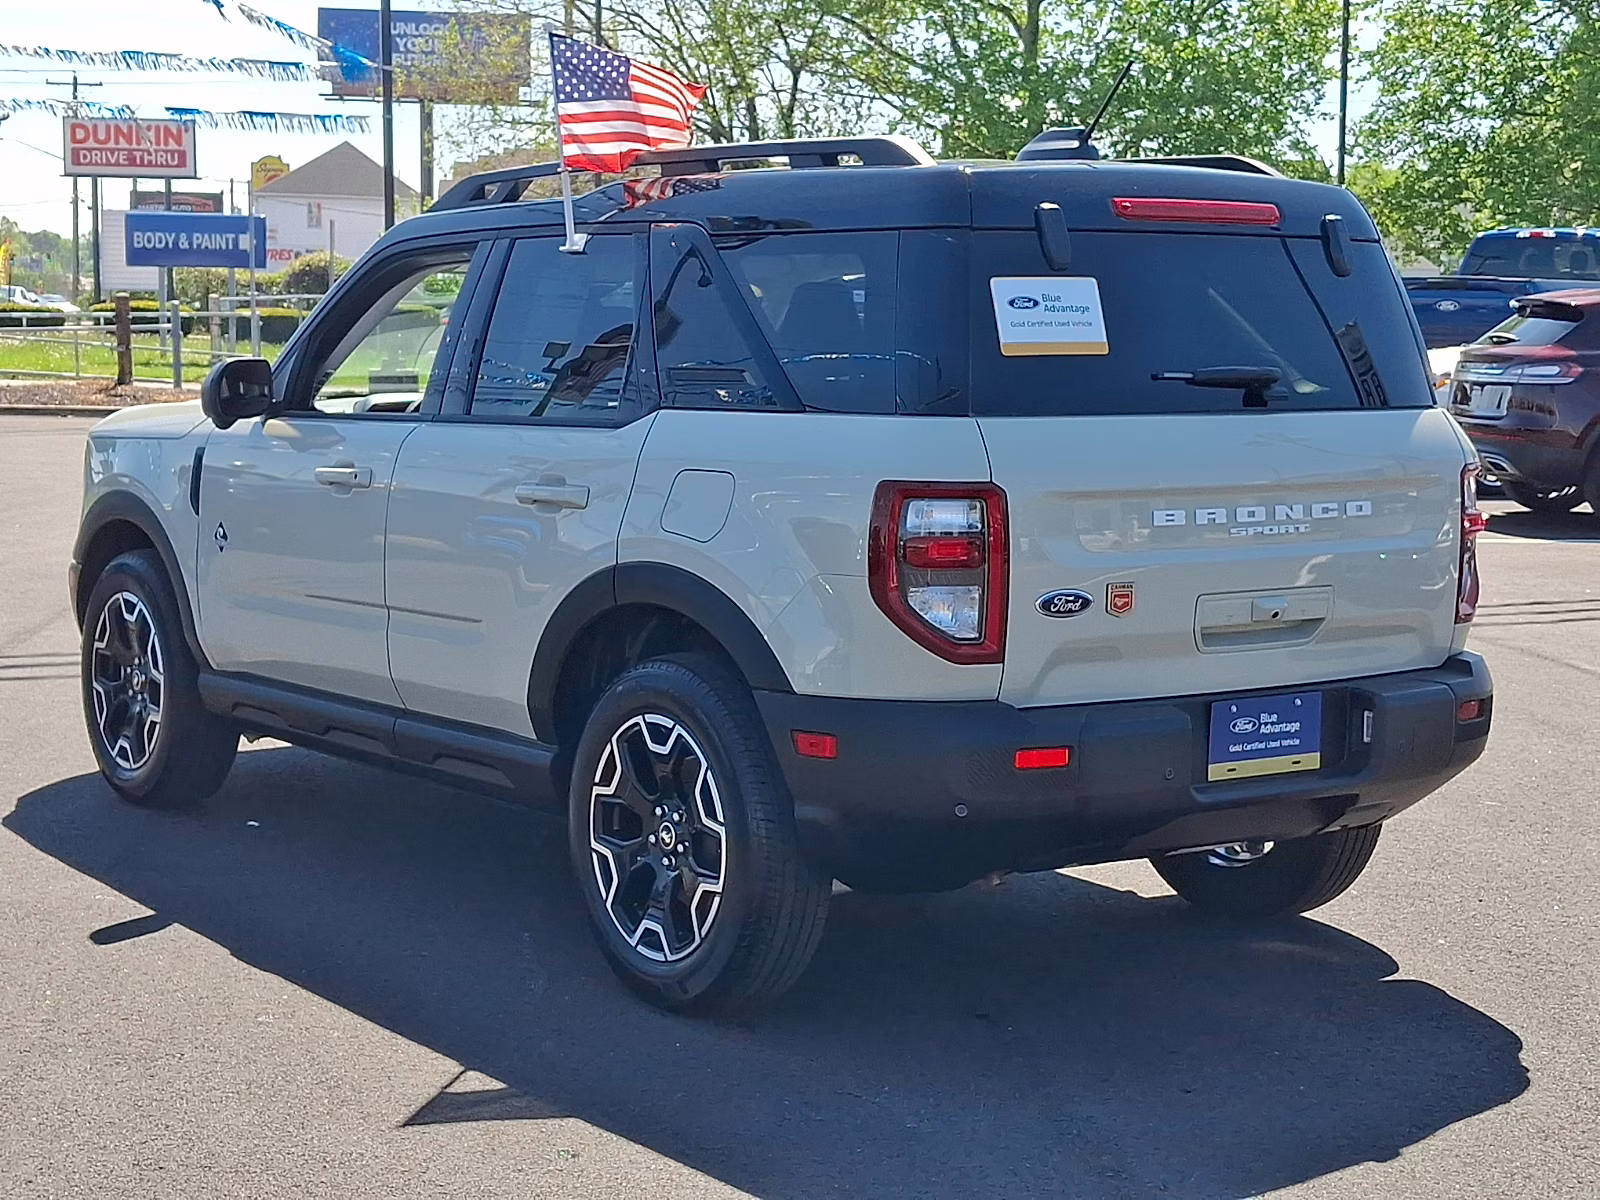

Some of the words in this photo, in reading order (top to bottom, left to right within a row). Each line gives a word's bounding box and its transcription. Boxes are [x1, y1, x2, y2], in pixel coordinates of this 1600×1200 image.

[395, 37, 442, 53] YOU
[80, 150, 128, 165] DRIVE
[133, 151, 179, 166] THRU
[133, 231, 175, 249] BODY
[178, 232, 190, 250] &
[193, 233, 236, 251] PAINT
[1041, 293, 1062, 303] Blue
[1043, 305, 1090, 315] Advantage
[1027, 320, 1053, 328] Certified
[1054, 320, 1070, 328] Used
[1152, 500, 1372, 527] BRONCO
[1229, 523, 1310, 537] SPORT
[1050, 594, 1082, 613] Ford
[1259, 713, 1278, 723] Blue
[1259, 722, 1300, 734] Advantage
[1229, 744, 1243, 752] Gold
[1243, 741, 1265, 750] Certified
[1281, 738, 1300, 746] Vehicle
